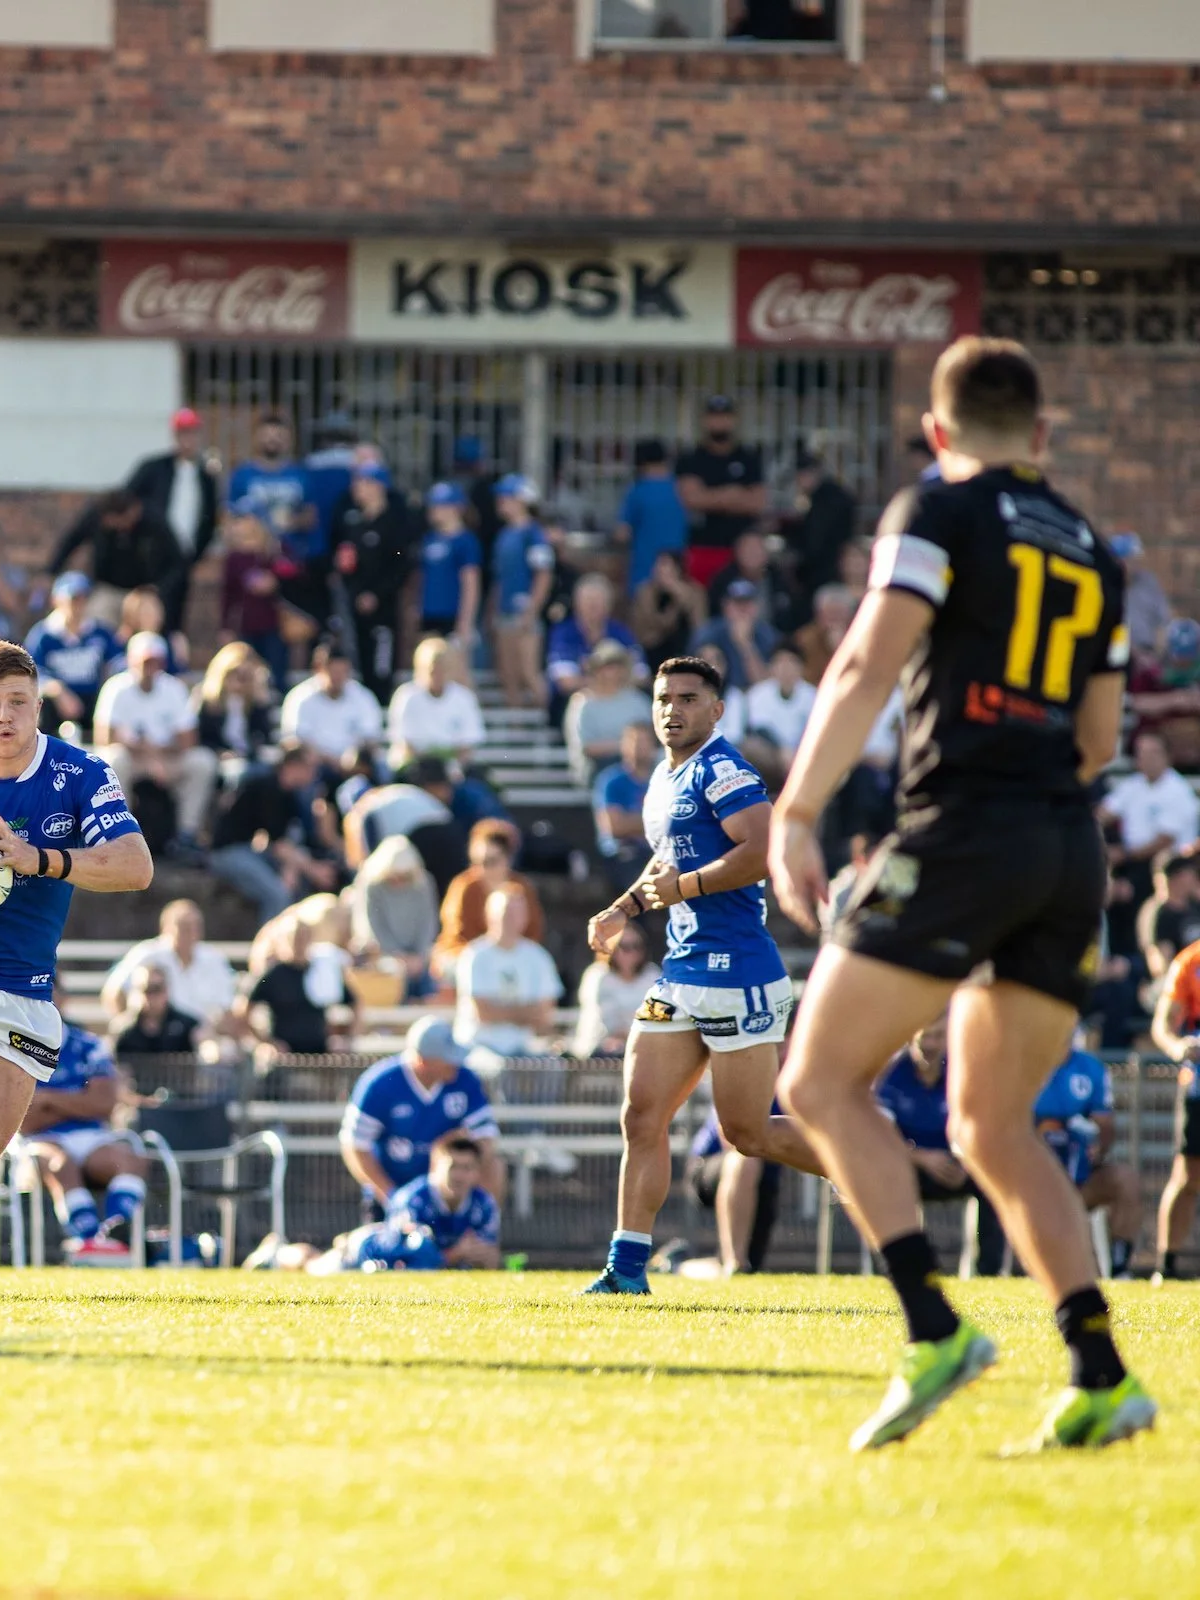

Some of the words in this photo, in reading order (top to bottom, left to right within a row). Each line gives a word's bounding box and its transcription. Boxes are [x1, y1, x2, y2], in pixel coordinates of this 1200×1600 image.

[390, 257, 689, 321] KIOSK
[50, 758, 84, 776] DEICORP
[45, 818, 73, 834] JETS
